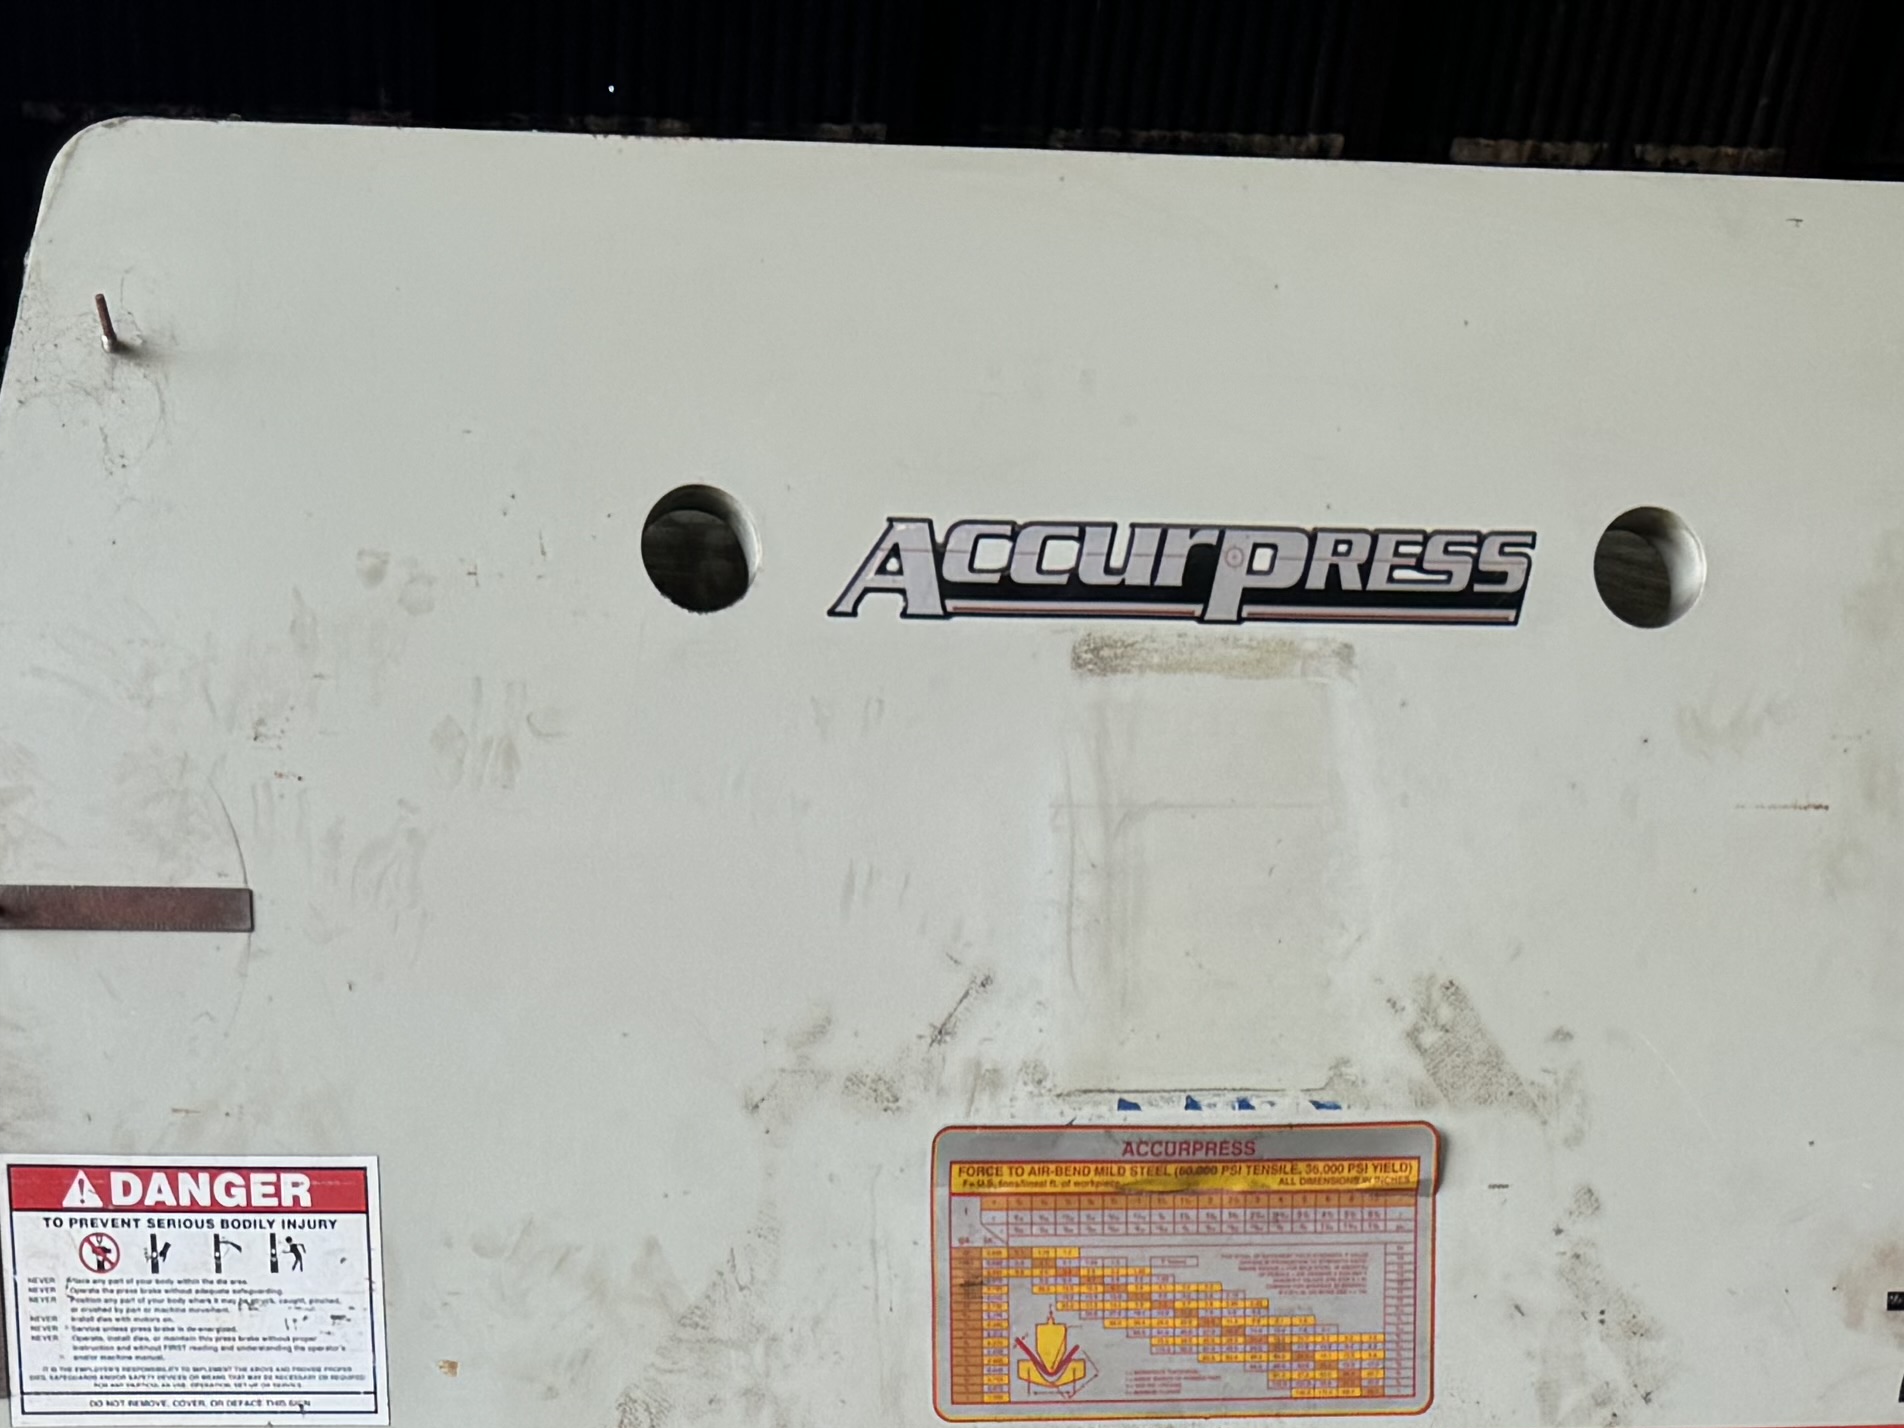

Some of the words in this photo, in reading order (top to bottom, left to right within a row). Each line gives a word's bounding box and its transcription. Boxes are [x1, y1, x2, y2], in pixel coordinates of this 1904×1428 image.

[1122, 1140, 1256, 1157] ACCURPRESS
[958, 1166, 1003, 1177] FORCE
[1008, 1167, 1025, 1177] TO
[1028, 1167, 1090, 1177] AIR-BEND
[1094, 1167, 1125, 1177] MILD
[1130, 1166, 1171, 1176] STEEL
[1221, 1165, 1241, 1176] PSI
[1348, 1163, 1368, 1174] PSI
[1372, 1162, 1413, 1174] YIELD)
[1279, 1177, 1296, 1185] ALL
[111, 1172, 311, 1208] DANGER
[43, 1217, 63, 1227] TO
[69, 1217, 140, 1228] PREVENT
[147, 1218, 214, 1229] SERIOUS
[220, 1218, 274, 1229] BODILY
[281, 1219, 336, 1229] INJURY
